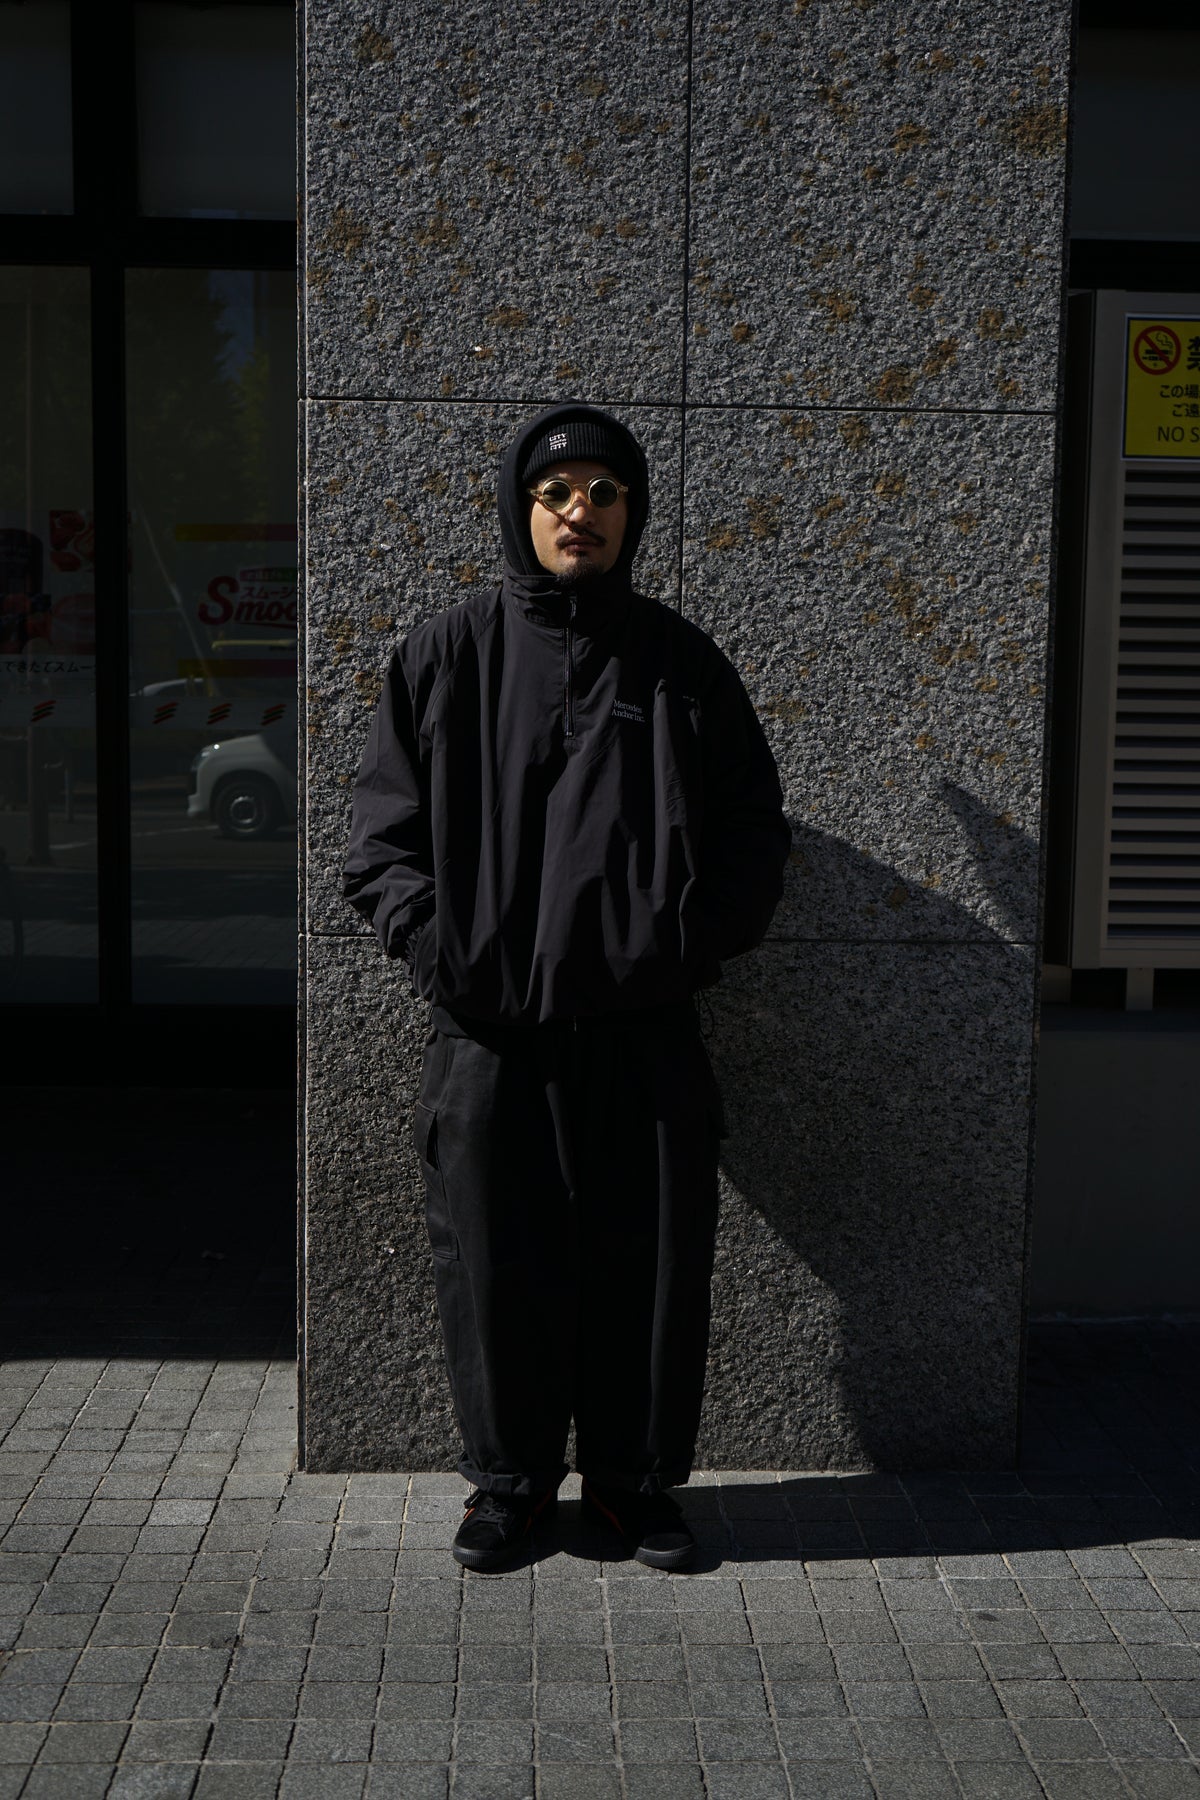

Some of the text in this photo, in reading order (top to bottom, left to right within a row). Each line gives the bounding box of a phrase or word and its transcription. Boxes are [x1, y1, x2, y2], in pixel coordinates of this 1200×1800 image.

[1158, 426, 1184, 442] NO
[0, 661, 96, 673] できたてスムー
